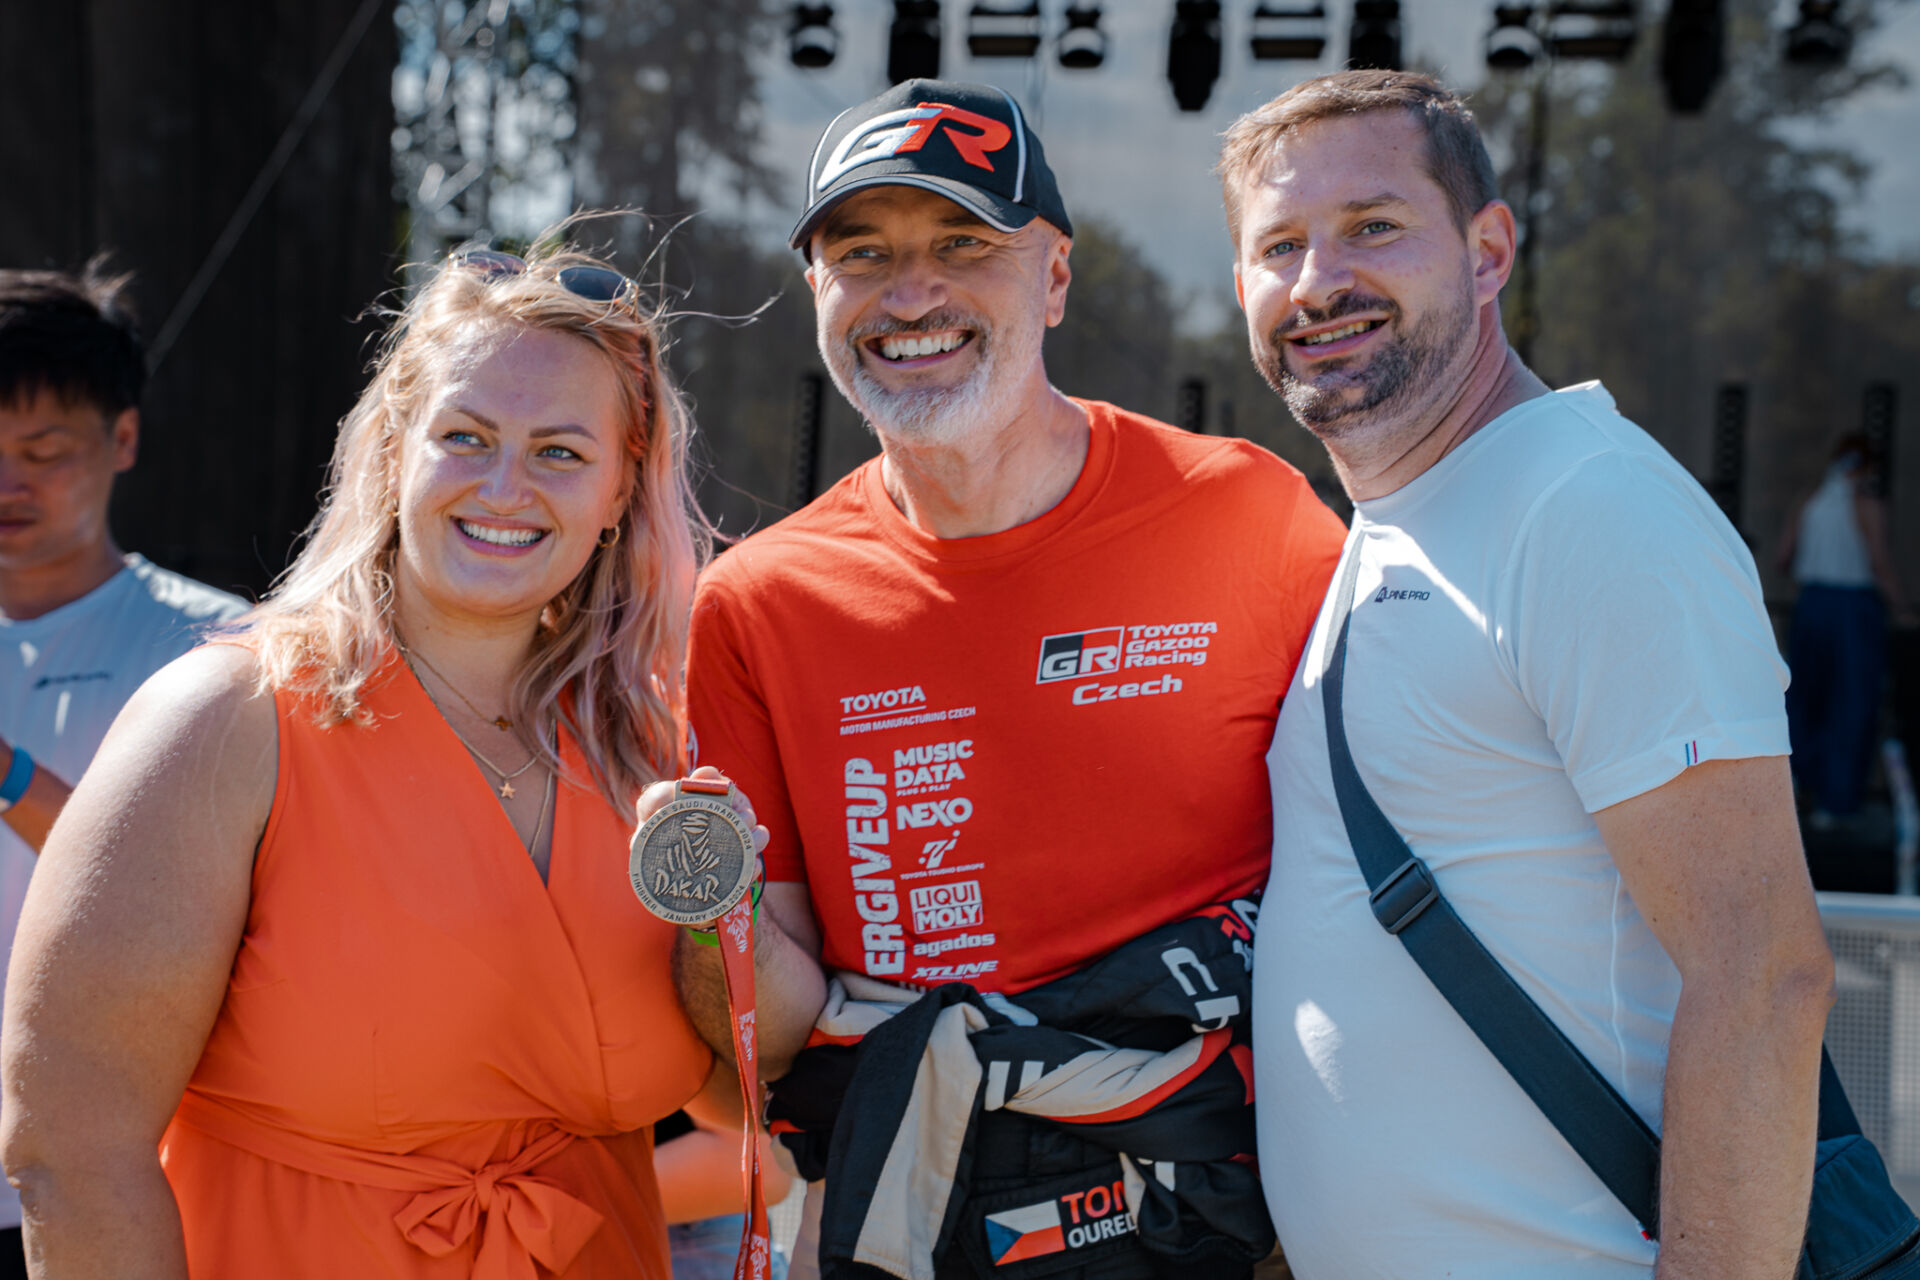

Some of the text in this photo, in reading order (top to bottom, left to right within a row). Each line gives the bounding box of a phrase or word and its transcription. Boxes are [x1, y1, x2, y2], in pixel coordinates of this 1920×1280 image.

[817, 101, 1012, 192] GR
[1408, 590, 1431, 601] PRO
[1127, 621, 1218, 639] TOYOTA
[1125, 635, 1210, 654] GAZOO
[1041, 645, 1118, 679] GR
[1124, 650, 1207, 669] Racing
[839, 685, 927, 714] TOYOTA
[1072, 674, 1183, 706] Czech
[839, 706, 977, 736] MOTOR MANUFACTURING CZECH
[893, 739, 975, 769] MUSIC
[894, 761, 966, 789] DATA
[671, 800, 705, 813] SAUDI
[707, 802, 741, 827] ARABIA
[896, 797, 973, 830] NEXO
[632, 872, 657, 912] FINISHER
[663, 912, 707, 923] JANUARY
[654, 868, 721, 903] DAKAR
[915, 884, 976, 909] LIQUI
[916, 904, 980, 931] MOLY
[913, 933, 996, 958] agados
[912, 960, 999, 979] XTLINE
